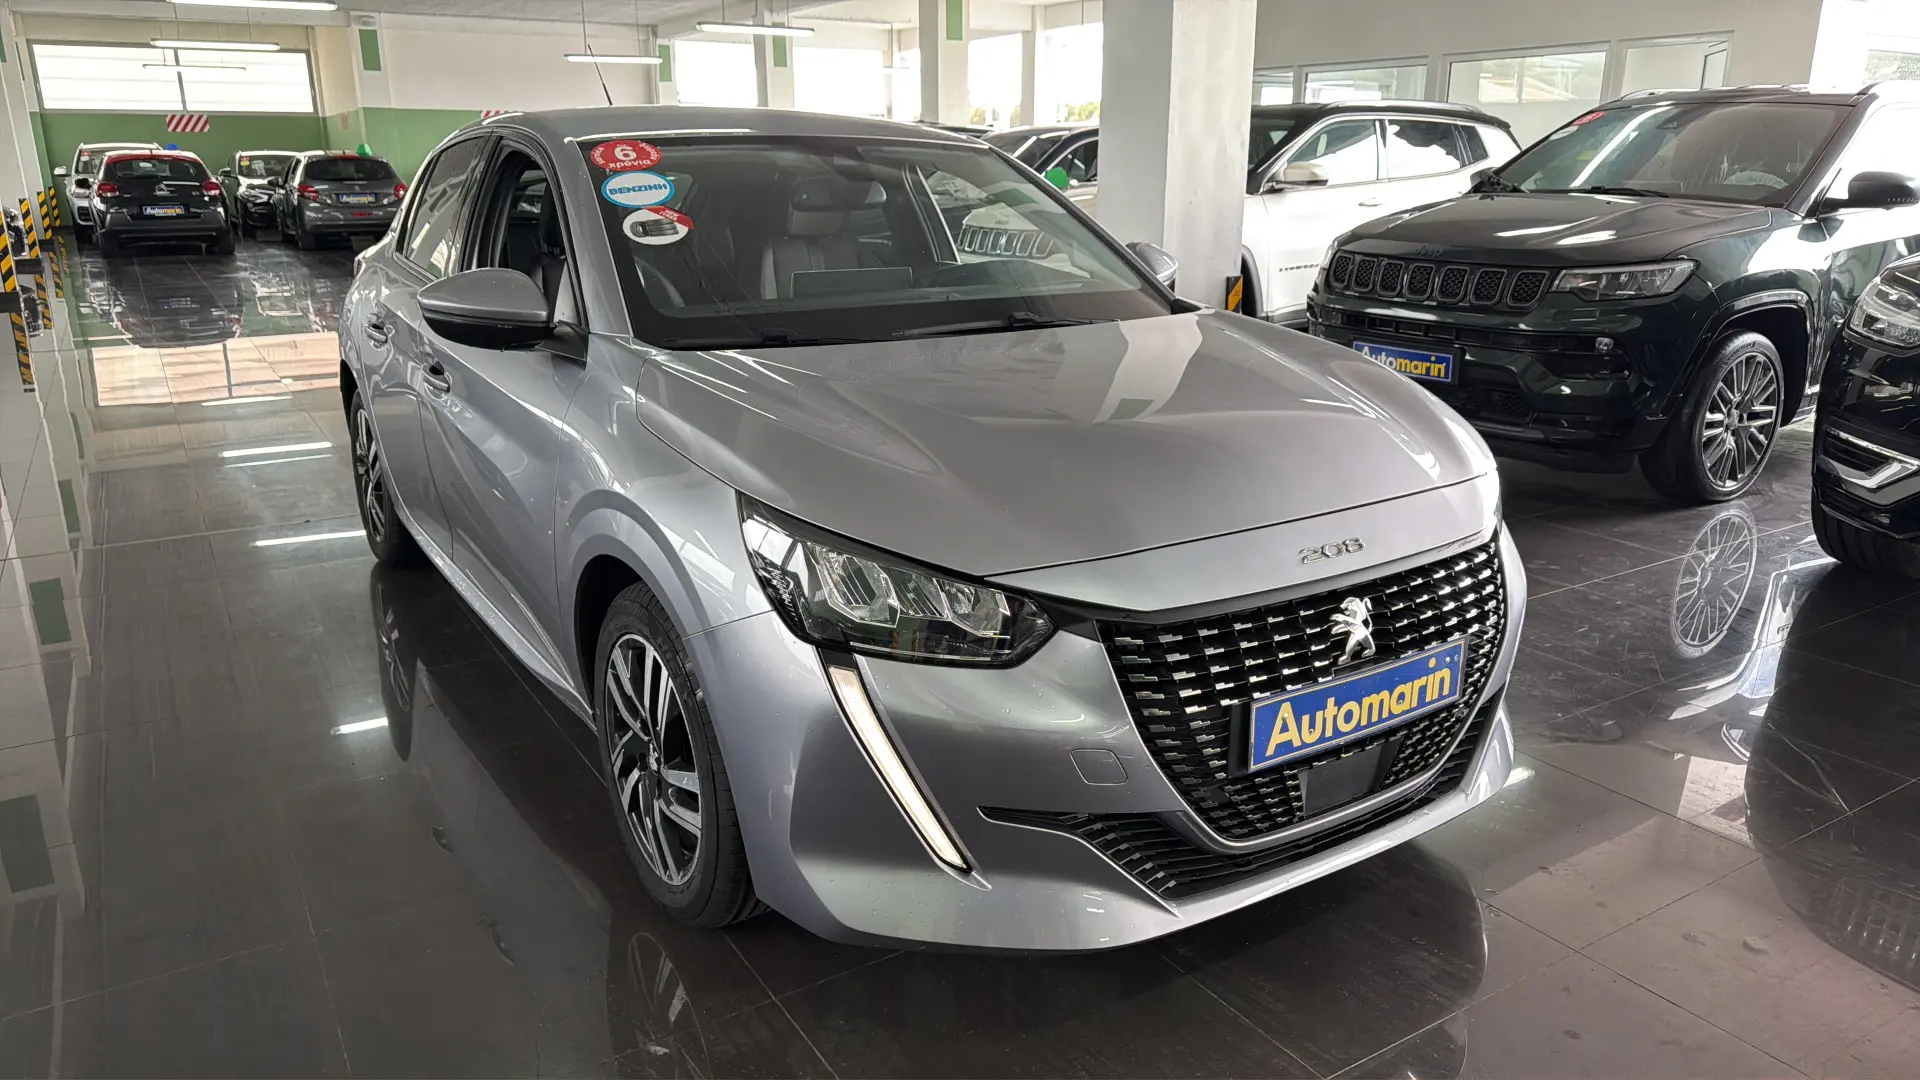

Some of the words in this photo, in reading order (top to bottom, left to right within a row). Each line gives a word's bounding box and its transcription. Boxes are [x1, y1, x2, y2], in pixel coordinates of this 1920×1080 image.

[614, 146, 637, 160] 6
[608, 160, 652, 169] χρόνια
[608, 183, 668, 195] ΒΕΝΖΙΝΗ
[145, 206, 182, 215] Automarin
[1298, 536, 1365, 564] 208
[1265, 657, 1451, 757] Automarin
